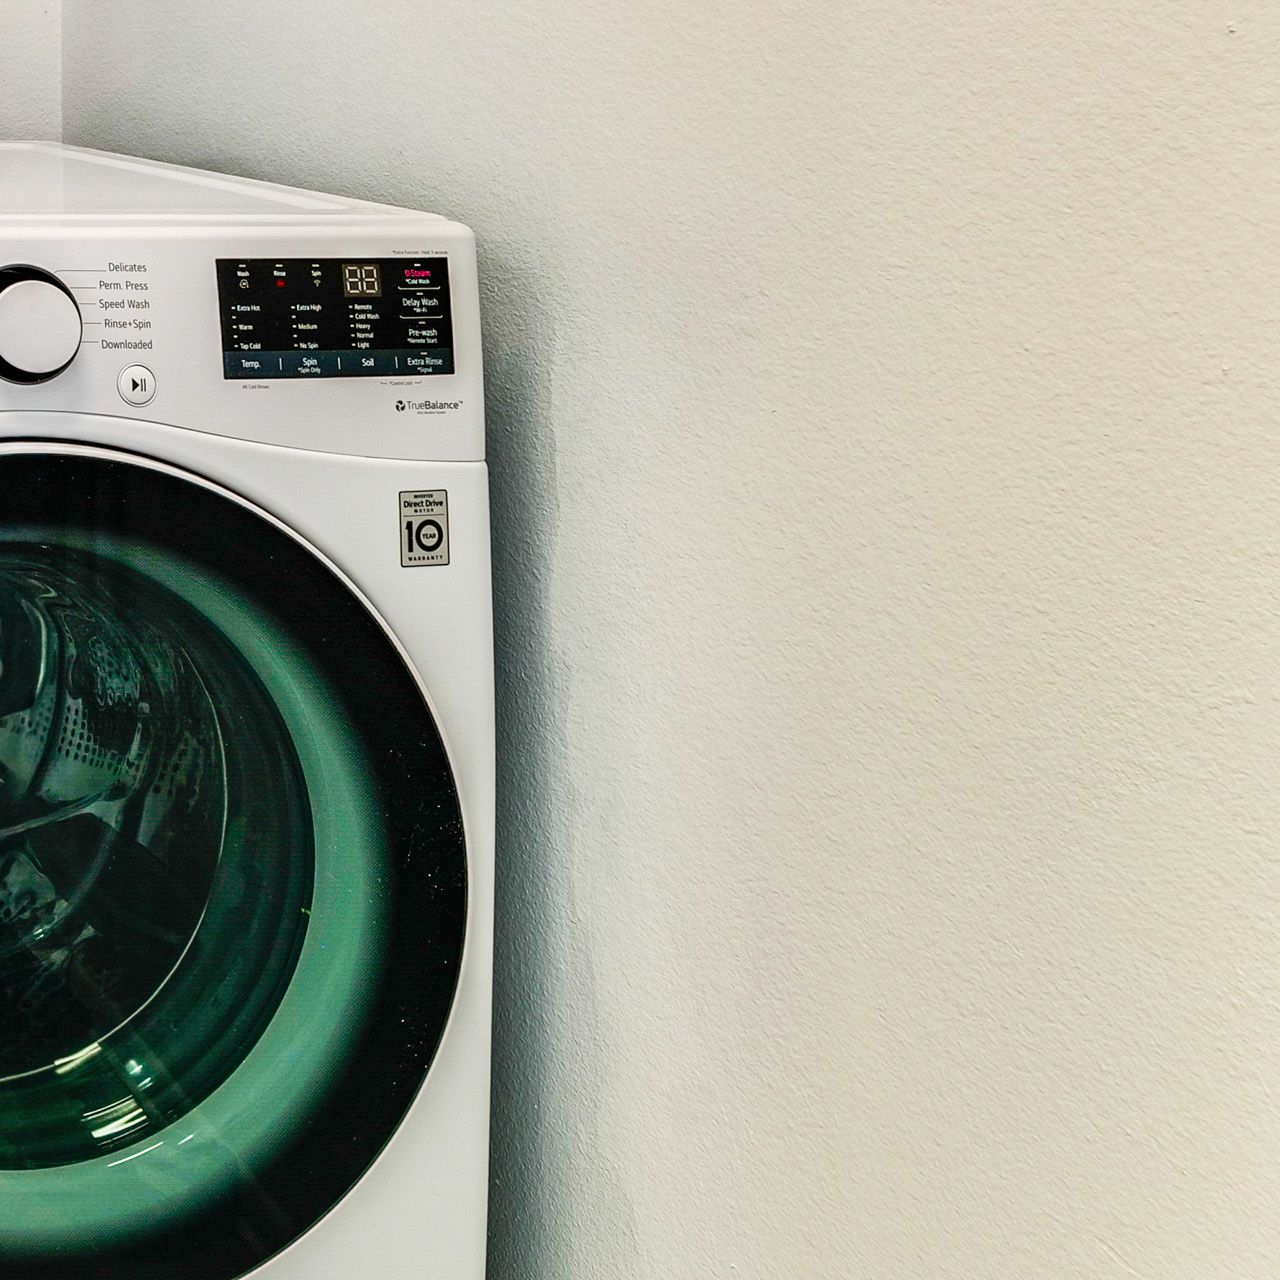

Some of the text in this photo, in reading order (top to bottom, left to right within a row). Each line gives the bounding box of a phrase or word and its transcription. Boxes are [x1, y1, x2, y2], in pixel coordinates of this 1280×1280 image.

[108, 262, 147, 272] Delicates
[99, 280, 149, 291] Perm. Press
[99, 299, 150, 310] Speed Wash
[402, 297, 439, 307] Delay Wash
[408, 328, 438, 336] Pre-wash
[101, 339, 153, 350] Downloaded
[241, 359, 261, 370] Temp.
[302, 357, 318, 367] Spin
[361, 357, 375, 367] Soil
[407, 357, 443, 366] Extra Rinse
[403, 499, 443, 508] Direct Drive
[405, 519, 444, 552] 10
[422, 532, 436, 540] YEAR
